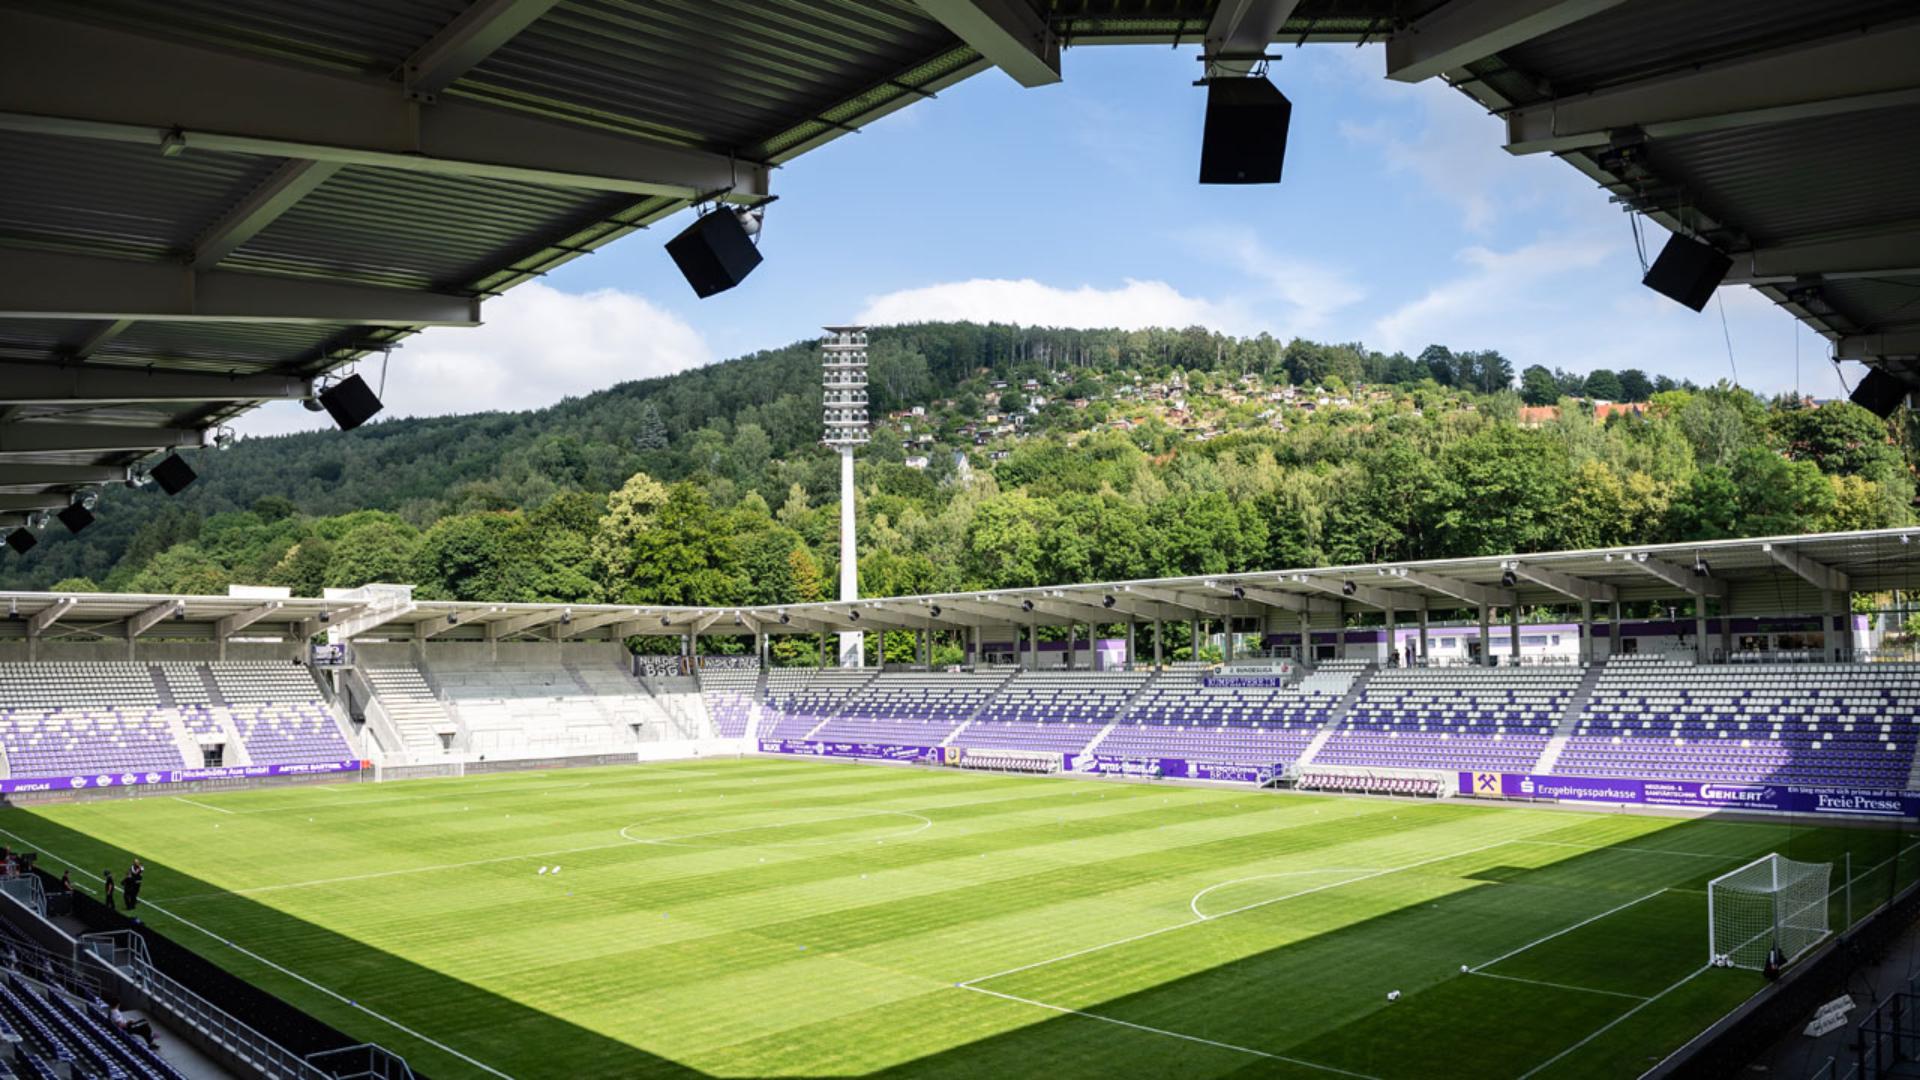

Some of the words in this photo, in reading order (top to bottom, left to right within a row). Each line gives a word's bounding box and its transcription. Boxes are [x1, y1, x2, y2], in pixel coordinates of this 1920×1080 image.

[646, 664, 679, 677] BSG
[1538, 784, 1637, 800] Erzgebirgssparkasse
[1700, 783, 1763, 801] GEHLERT
[1817, 794, 1854, 808] Freie
[1854, 795, 1902, 811] Presse
